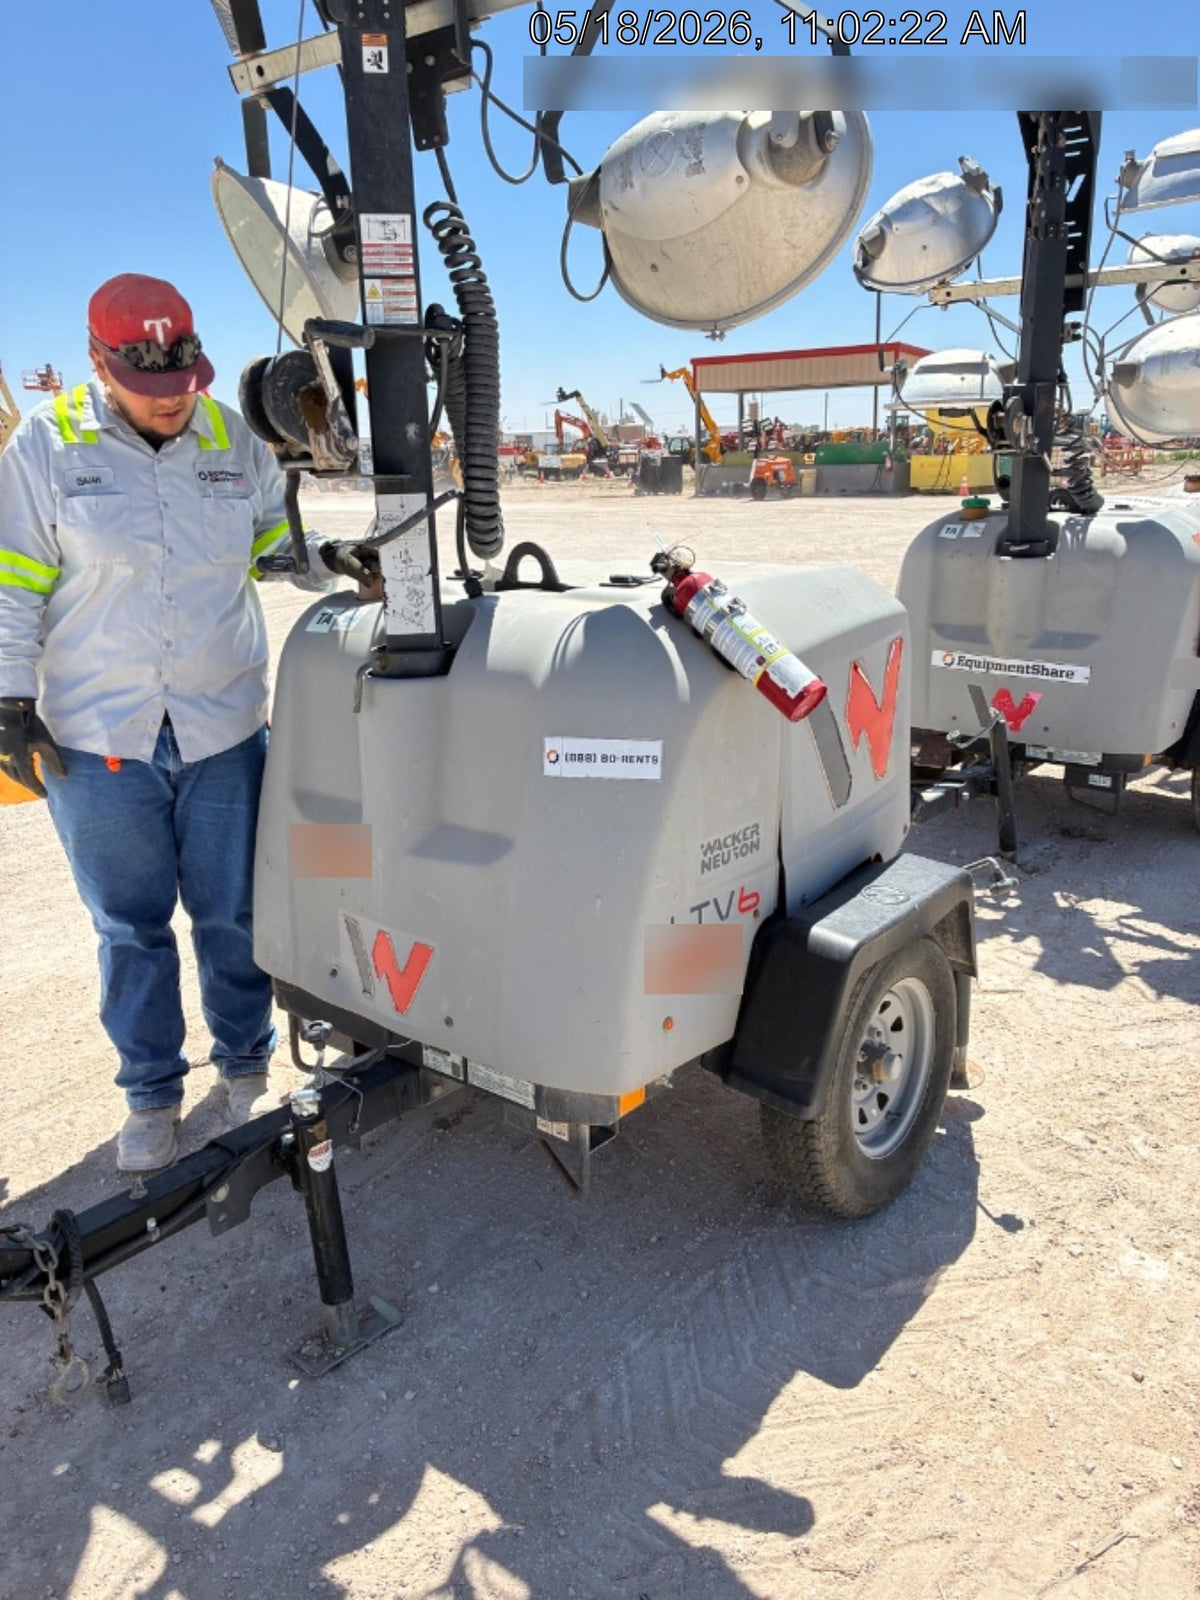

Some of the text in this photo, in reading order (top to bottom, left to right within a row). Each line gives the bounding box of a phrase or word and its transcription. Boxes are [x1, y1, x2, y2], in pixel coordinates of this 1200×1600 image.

[143, 316, 172, 348] T
[956, 654, 1076, 680] EquipmentShare
[700, 822, 760, 857] WACKER
[701, 837, 760, 875] NEUSON
[669, 886, 760, 925] TV6
